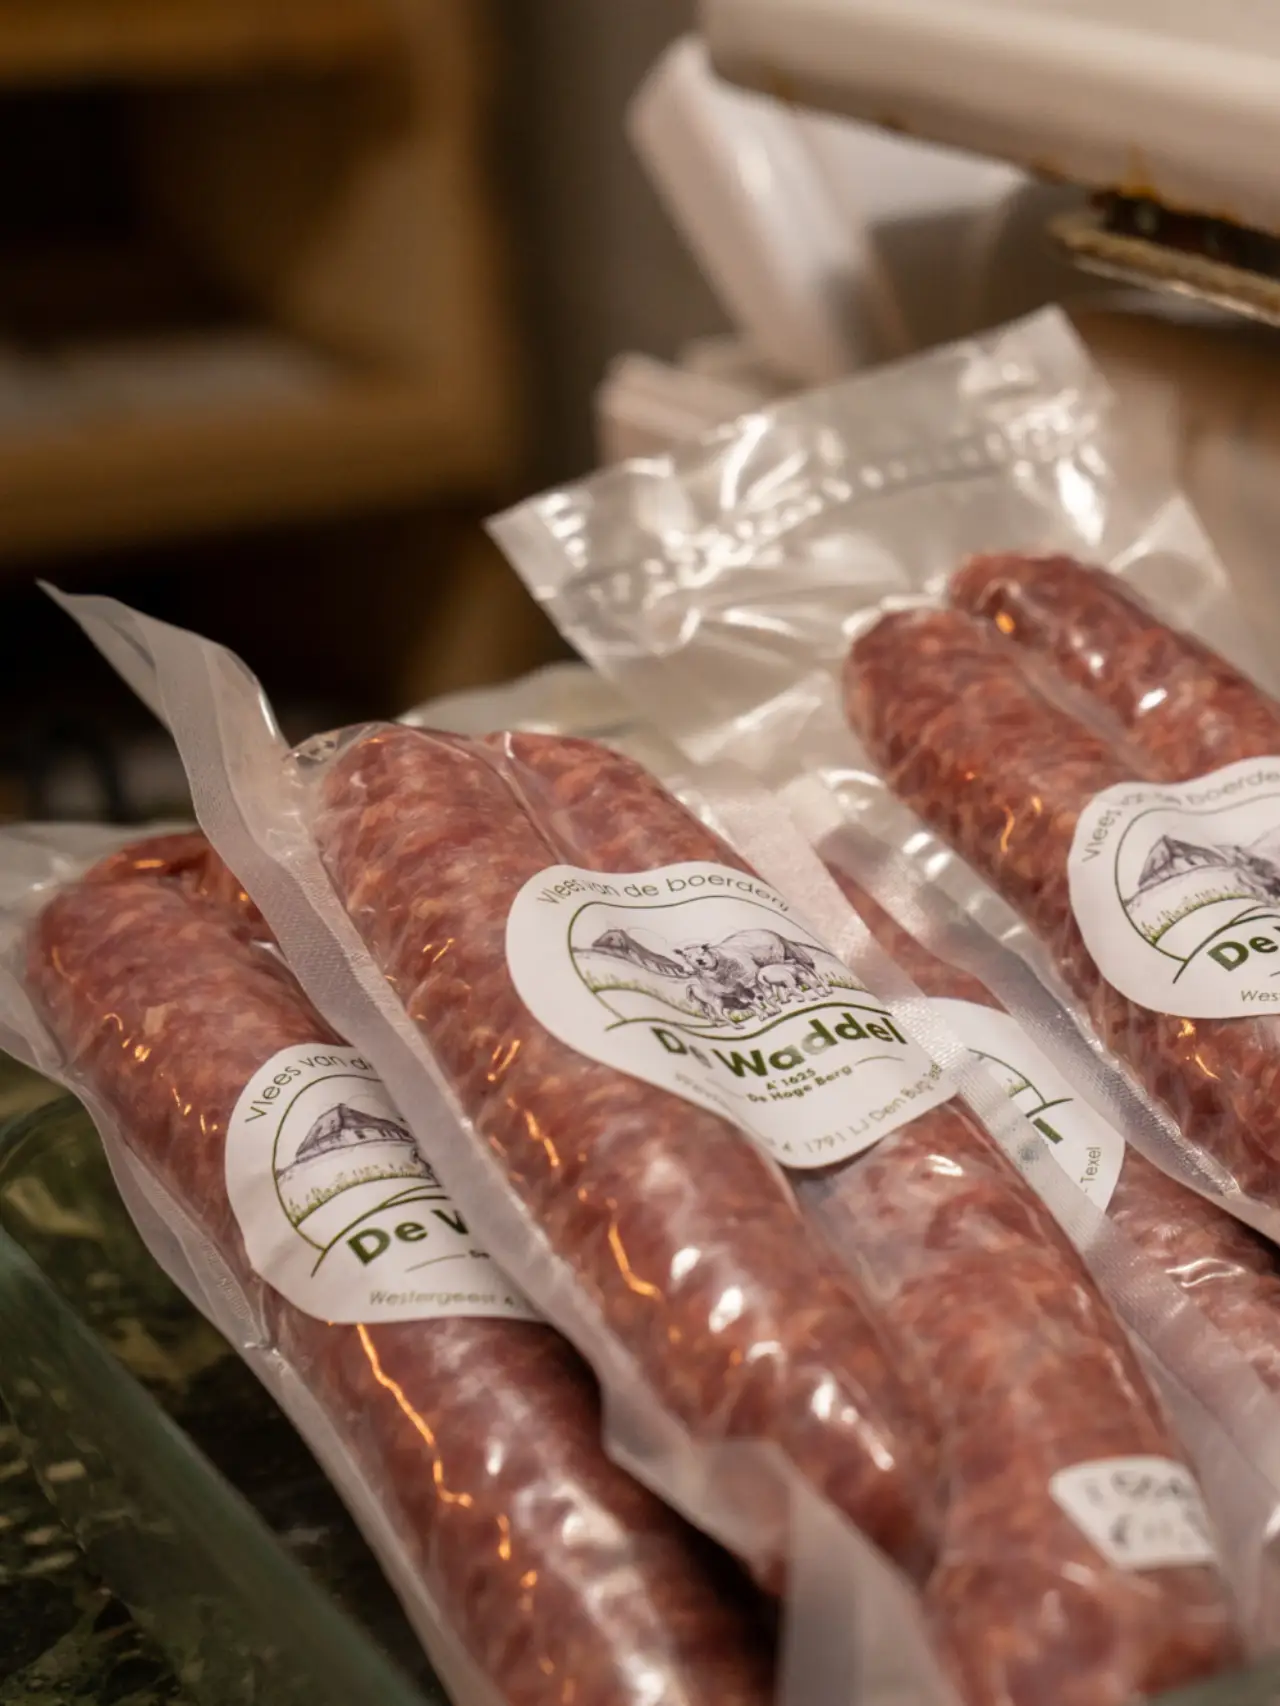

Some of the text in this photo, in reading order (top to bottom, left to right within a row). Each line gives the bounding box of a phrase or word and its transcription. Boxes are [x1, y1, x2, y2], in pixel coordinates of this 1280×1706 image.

[623, 883, 660, 898] de
[1207, 935, 1279, 972] De
[711, 1012, 909, 1079] Waddel
[244, 1065, 301, 1123] Vlees
[298, 1055, 348, 1068] van
[780, 1067, 817, 1087] 1625
[814, 1065, 853, 1087] Berg
[868, 1096, 907, 1122] Den
[1080, 1146, 1101, 1184] Texel
[346, 1221, 428, 1267] De
